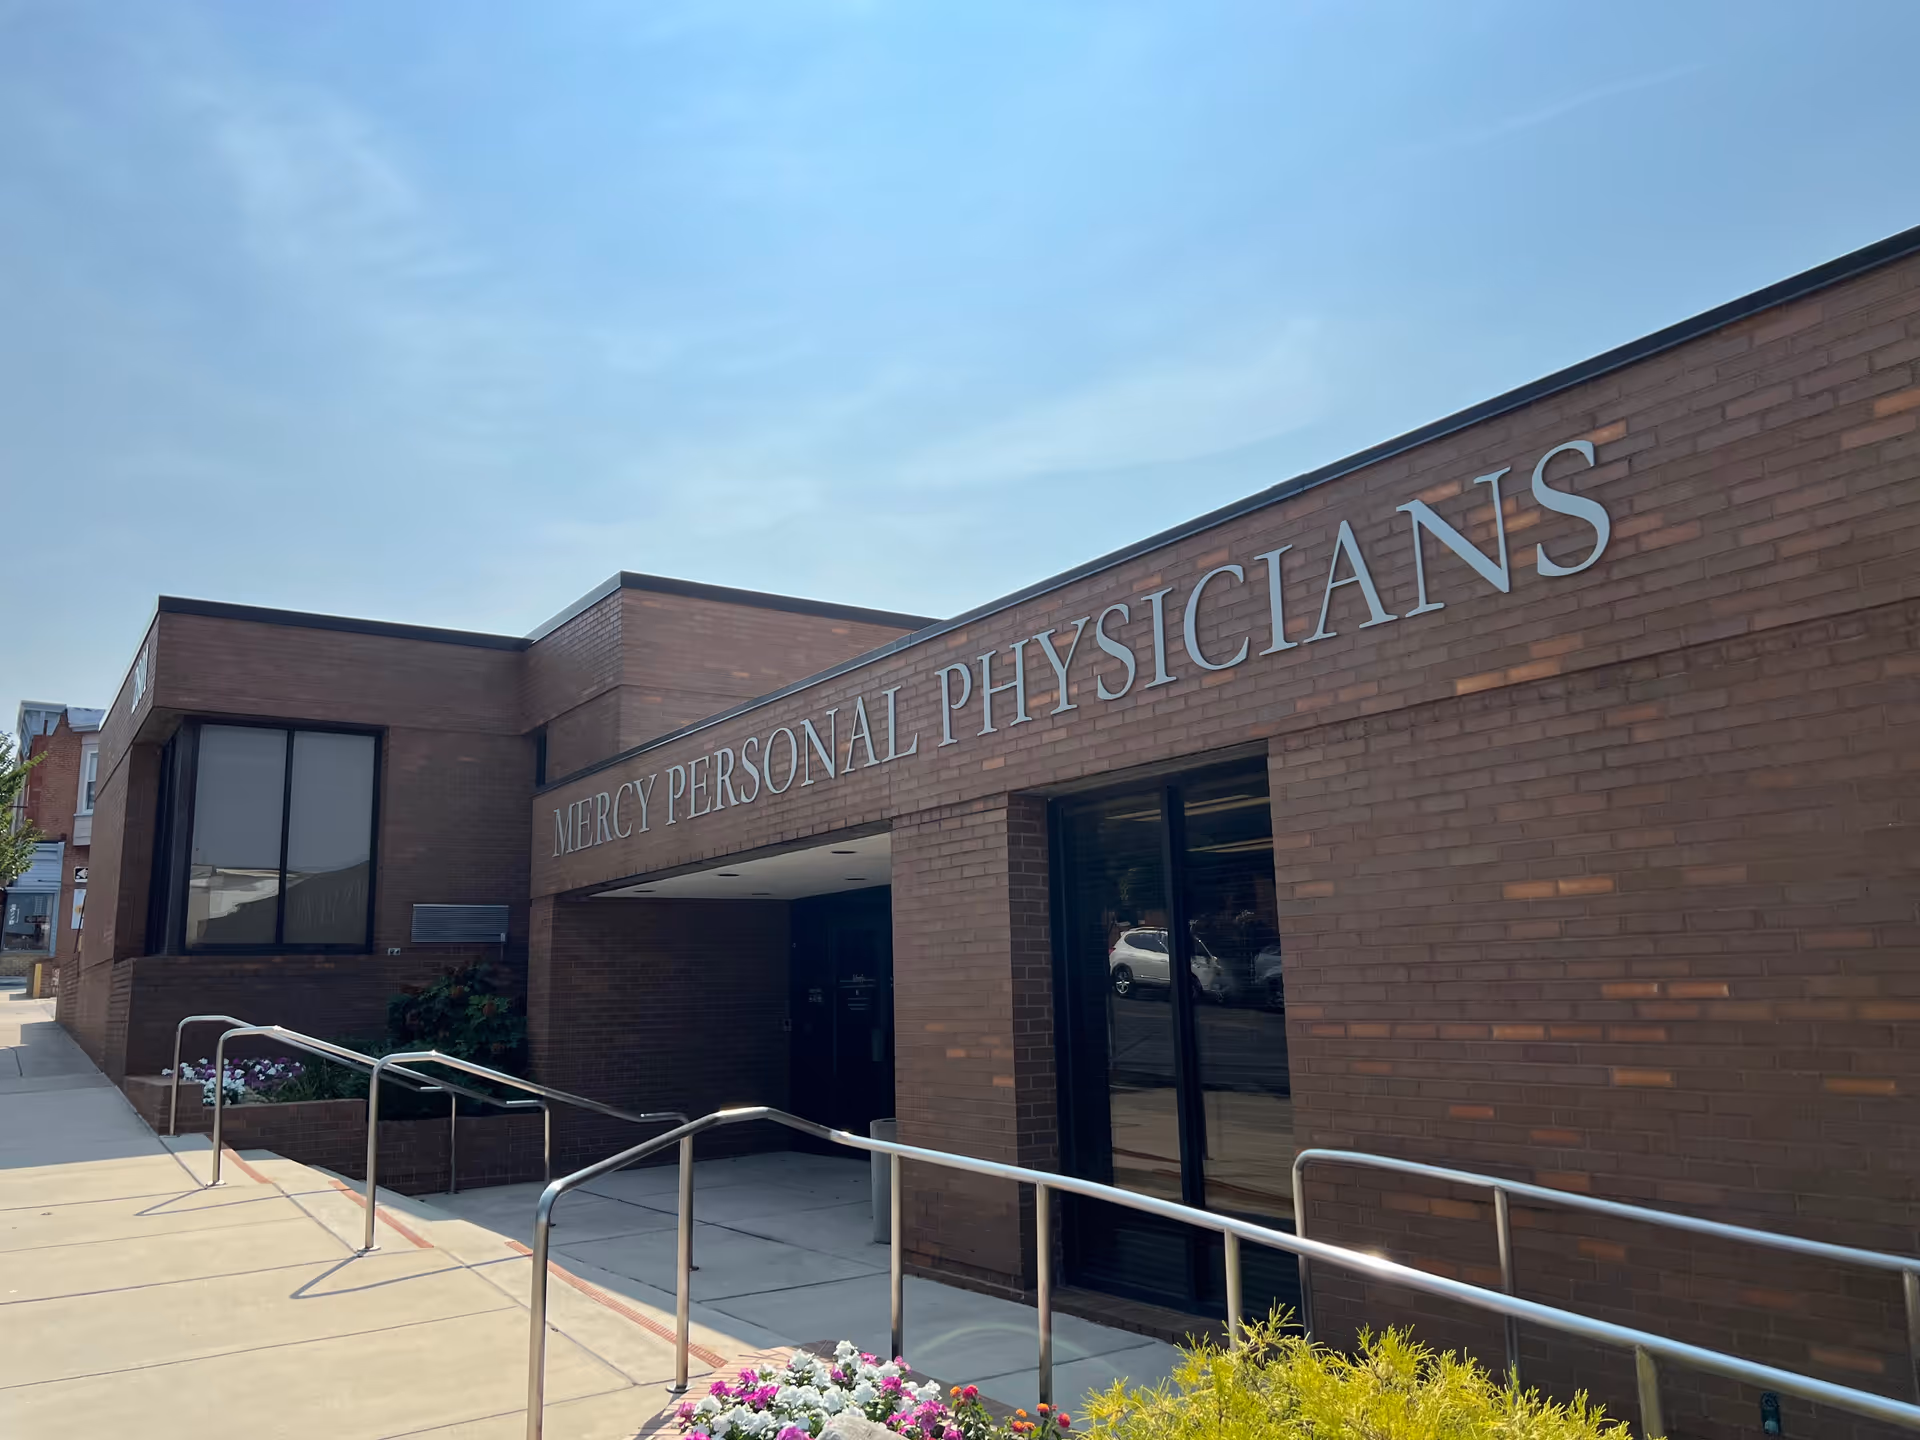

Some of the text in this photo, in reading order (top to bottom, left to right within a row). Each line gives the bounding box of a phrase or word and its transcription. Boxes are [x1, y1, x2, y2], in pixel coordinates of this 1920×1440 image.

[552, 440, 1611, 858] MERCY PERSONAL PHYSICIANS
